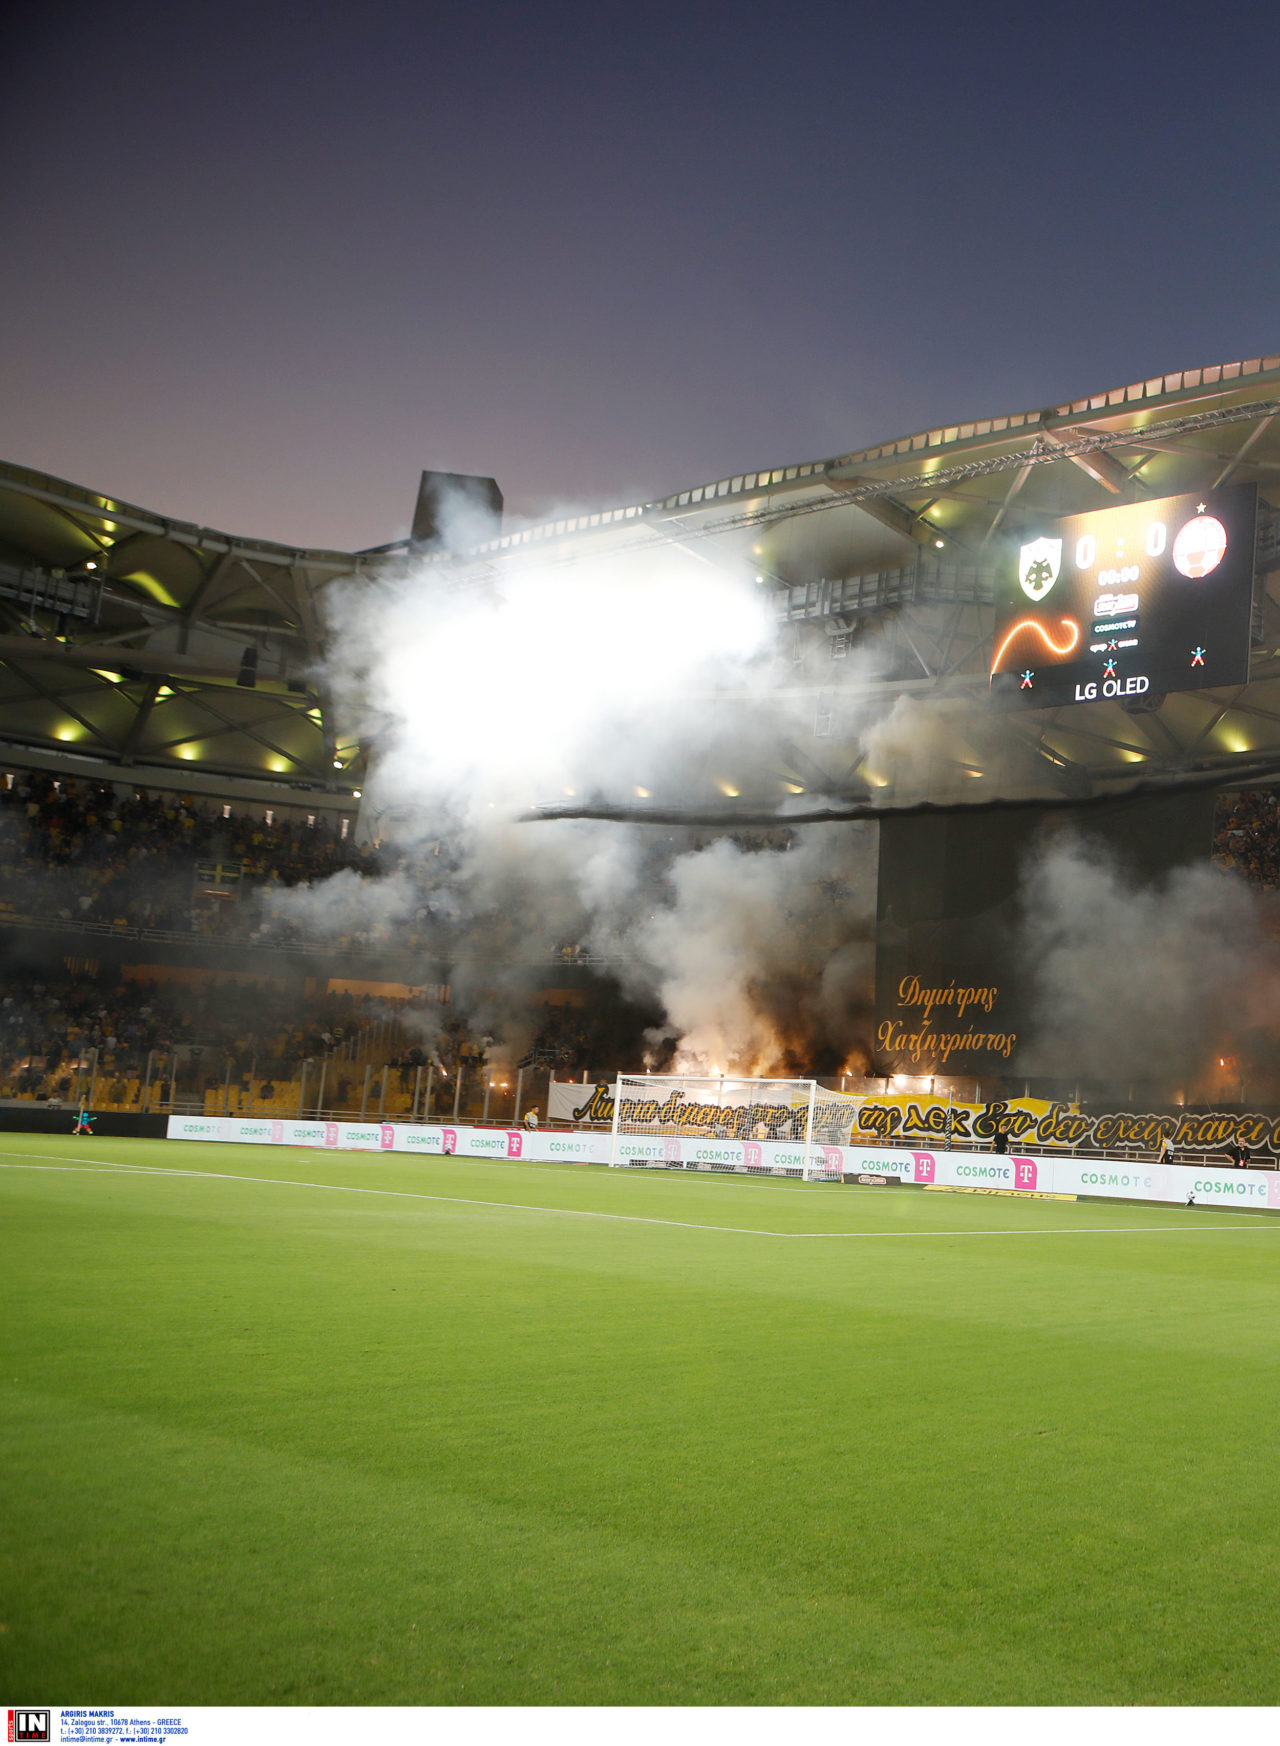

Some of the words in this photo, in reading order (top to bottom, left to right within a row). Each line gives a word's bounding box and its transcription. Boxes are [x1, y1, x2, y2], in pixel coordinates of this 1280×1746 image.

[1075, 683, 1097, 700] LG
[1102, 676, 1149, 698] OLED
[406, 1135, 440, 1145] COSMOTE
[470, 1139, 505, 1149] COSMOTE
[861, 1160, 911, 1172] COSMOTE
[956, 1165, 1010, 1179] COSMOTE
[1194, 1180, 1267, 1196] COSMOTE
